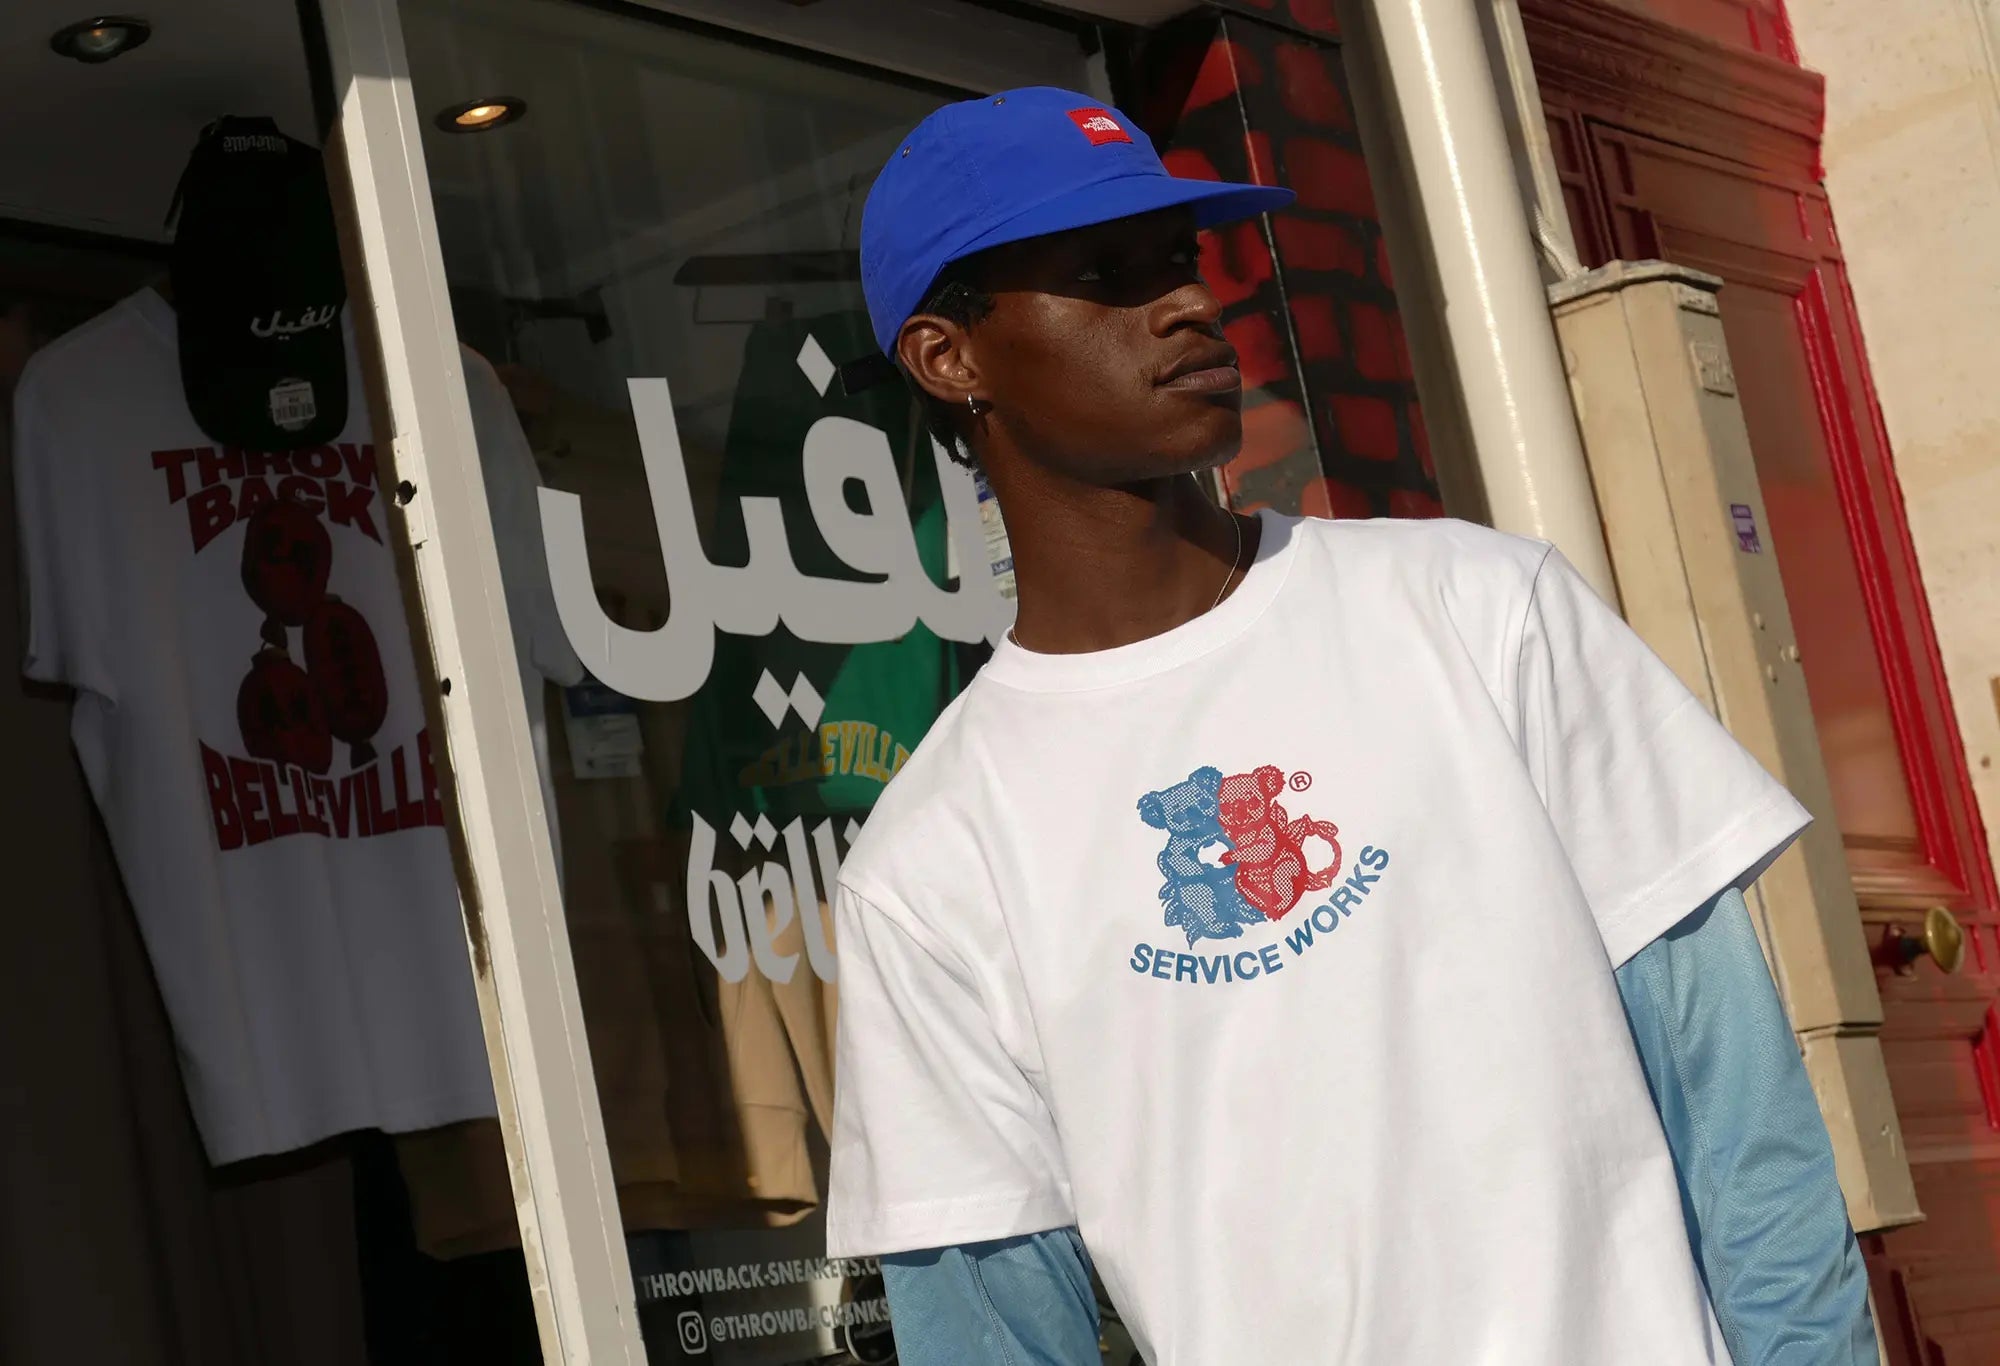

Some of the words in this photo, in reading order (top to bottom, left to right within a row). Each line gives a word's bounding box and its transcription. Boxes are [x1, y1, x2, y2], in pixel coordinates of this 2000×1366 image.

[151, 443, 381, 505] THROW
[186, 475, 384, 555] BACK
[1130, 942, 1284, 984] SERVICE
[1284, 845, 1390, 956] WORKS
